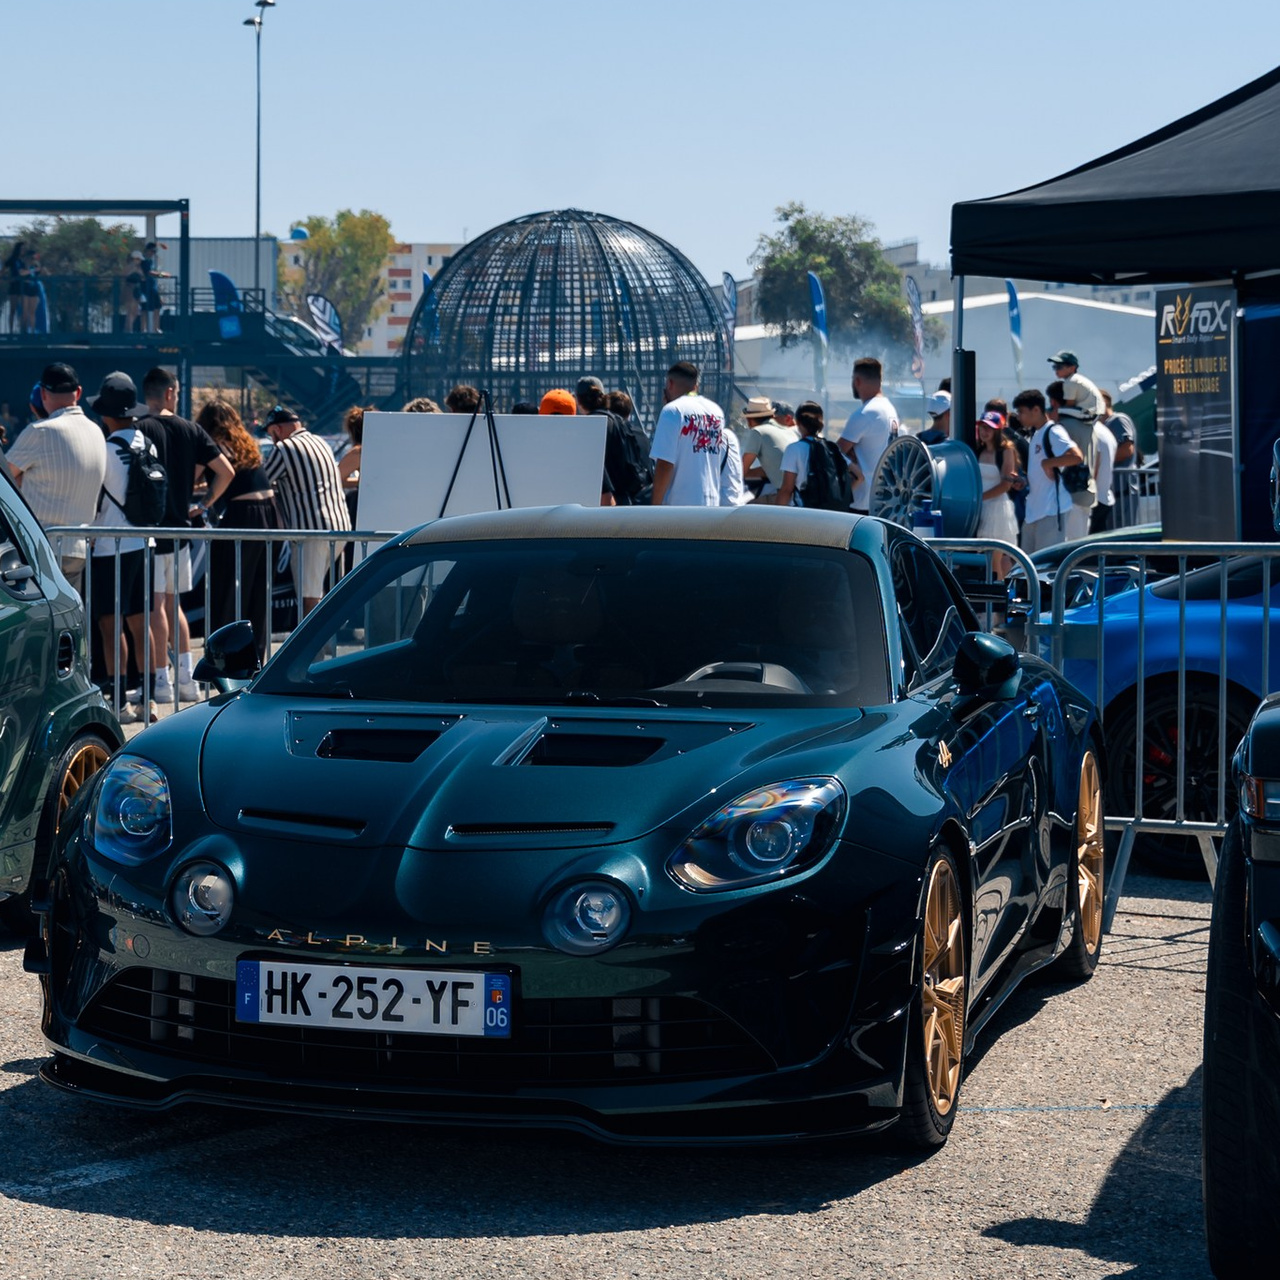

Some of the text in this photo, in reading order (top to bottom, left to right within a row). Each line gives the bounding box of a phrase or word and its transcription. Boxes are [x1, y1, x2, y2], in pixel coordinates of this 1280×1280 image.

[267, 928, 491, 955] ALPINE
[244, 992, 252, 1005] F
[265, 970, 475, 1026] HK-252-YF
[486, 1007, 508, 1027] 06
